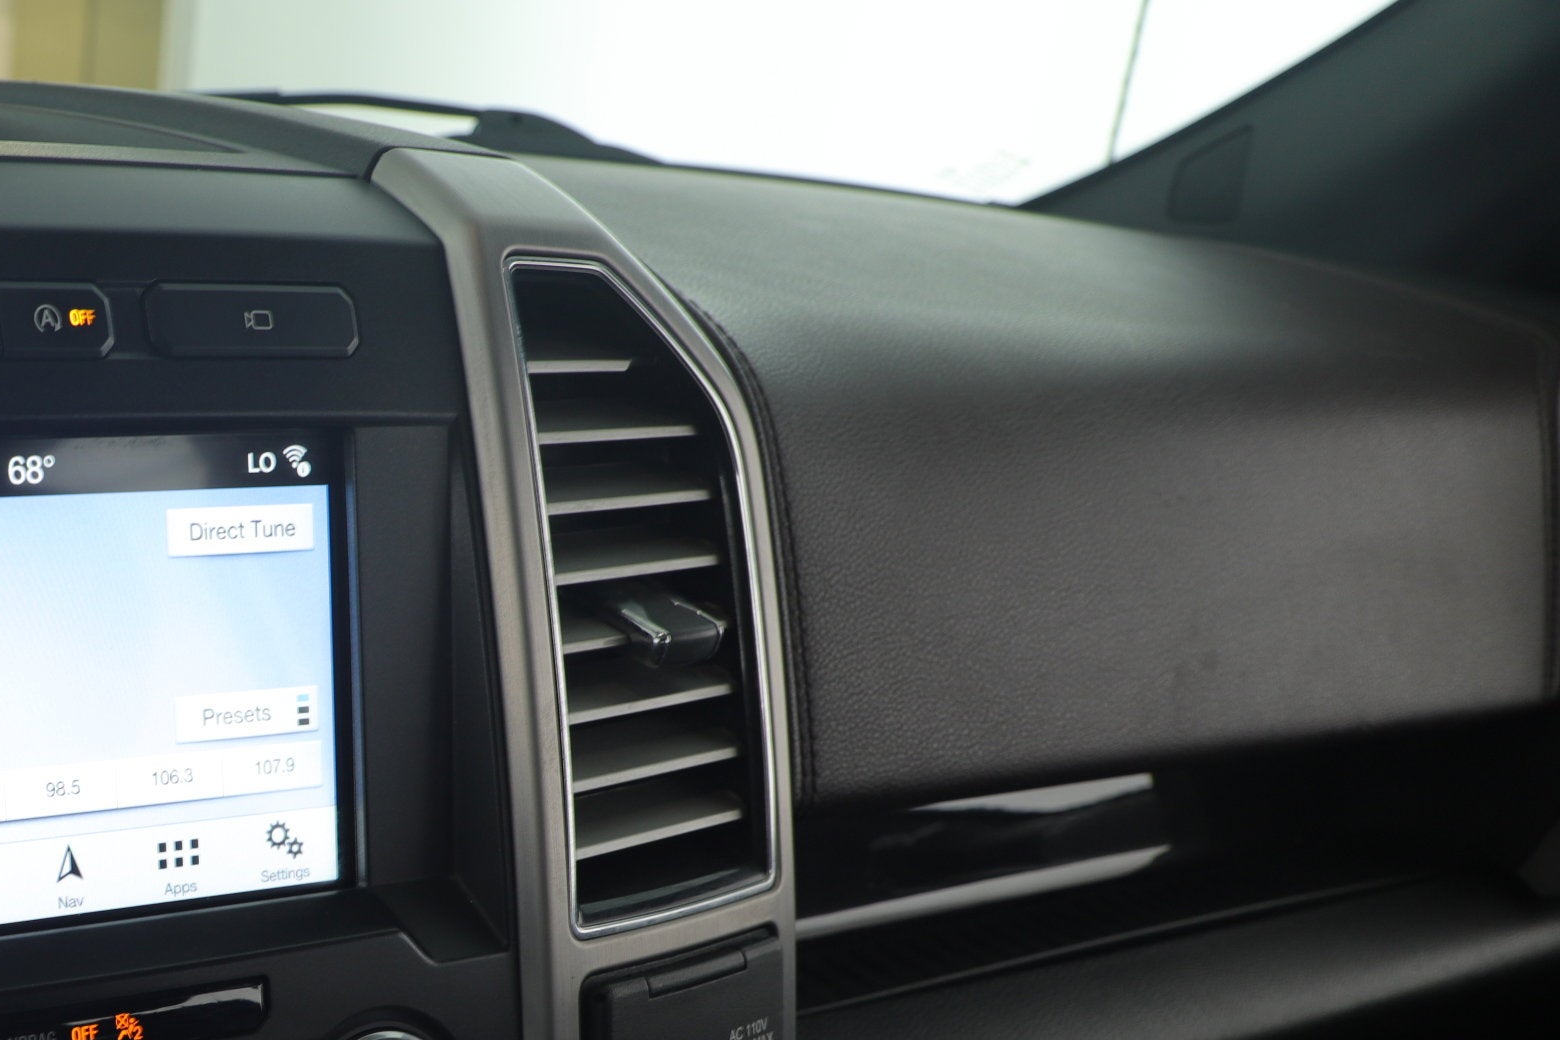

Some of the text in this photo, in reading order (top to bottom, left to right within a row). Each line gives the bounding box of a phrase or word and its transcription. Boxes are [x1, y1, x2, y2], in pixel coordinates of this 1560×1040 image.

[69, 308, 96, 326] OFF
[7, 455, 56, 485] 68°
[247, 450, 277, 475] LO
[189, 518, 296, 542] Direct Tune
[202, 704, 272, 727] Presets
[255, 757, 296, 776] 107.9
[151, 767, 194, 787] 106.3
[45, 779, 81, 799] 98.5
[260, 864, 311, 884] Settings
[164, 880, 198, 898] Apps
[57, 894, 85, 911] Nav
[746, 1017, 768, 1037] 110V
